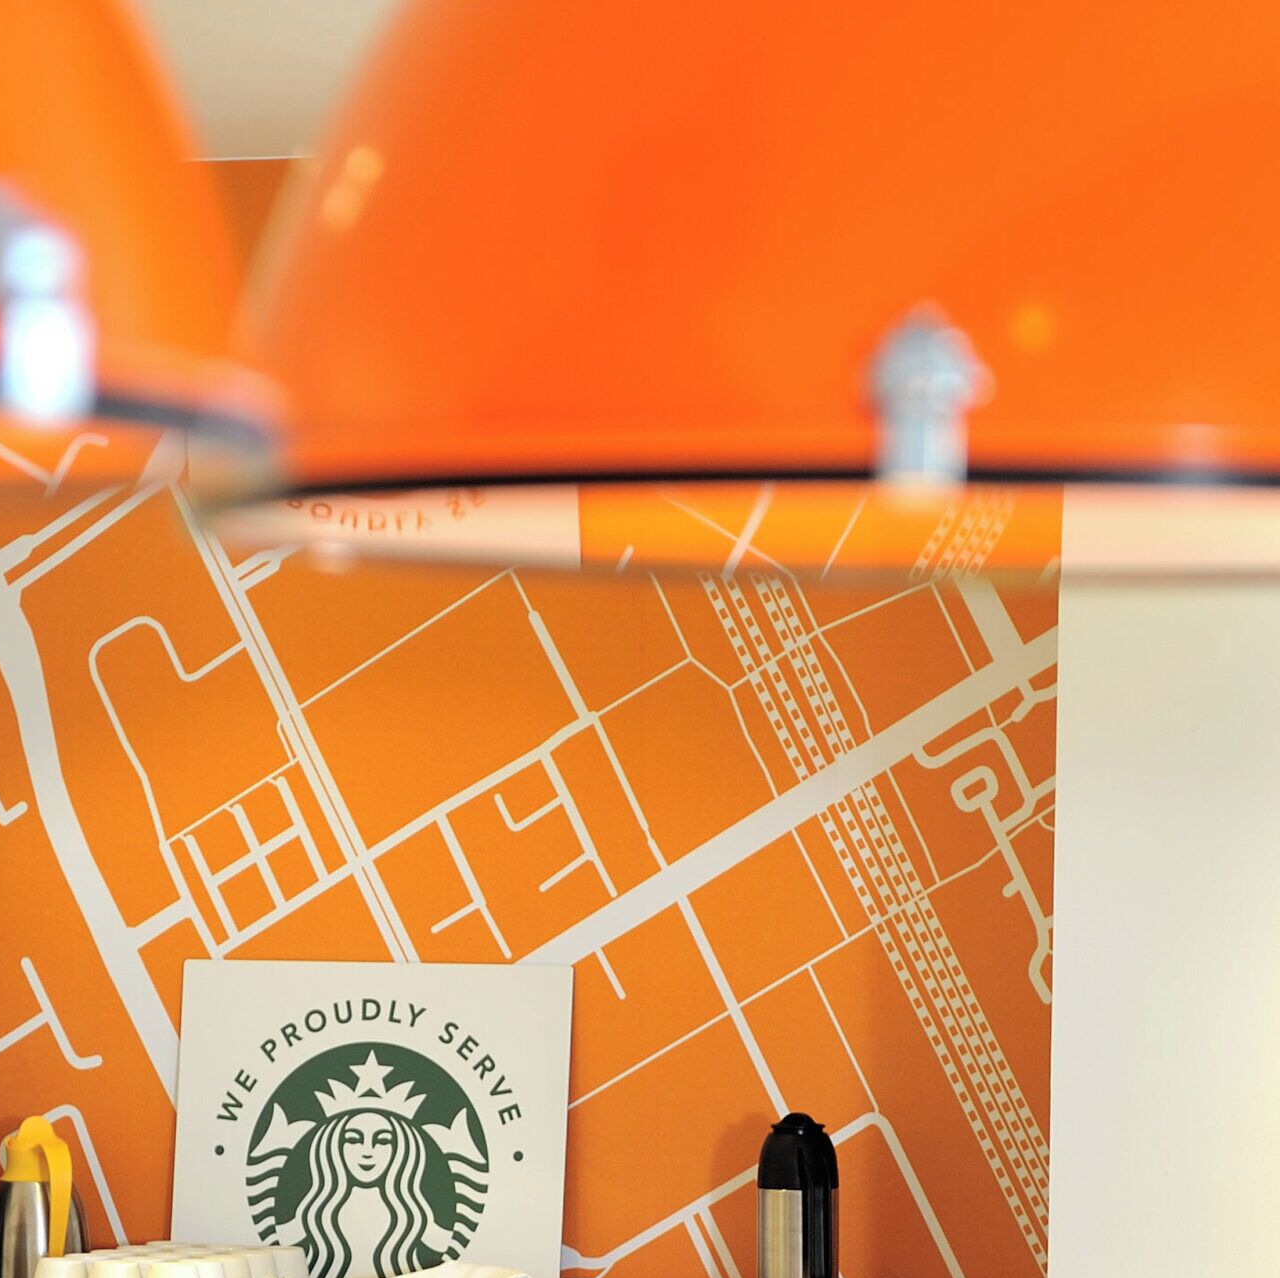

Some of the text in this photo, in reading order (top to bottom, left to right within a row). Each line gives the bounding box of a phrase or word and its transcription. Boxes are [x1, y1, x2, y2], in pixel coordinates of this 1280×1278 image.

[216, 998, 522, 1126] WE PROUDLY SERVE
